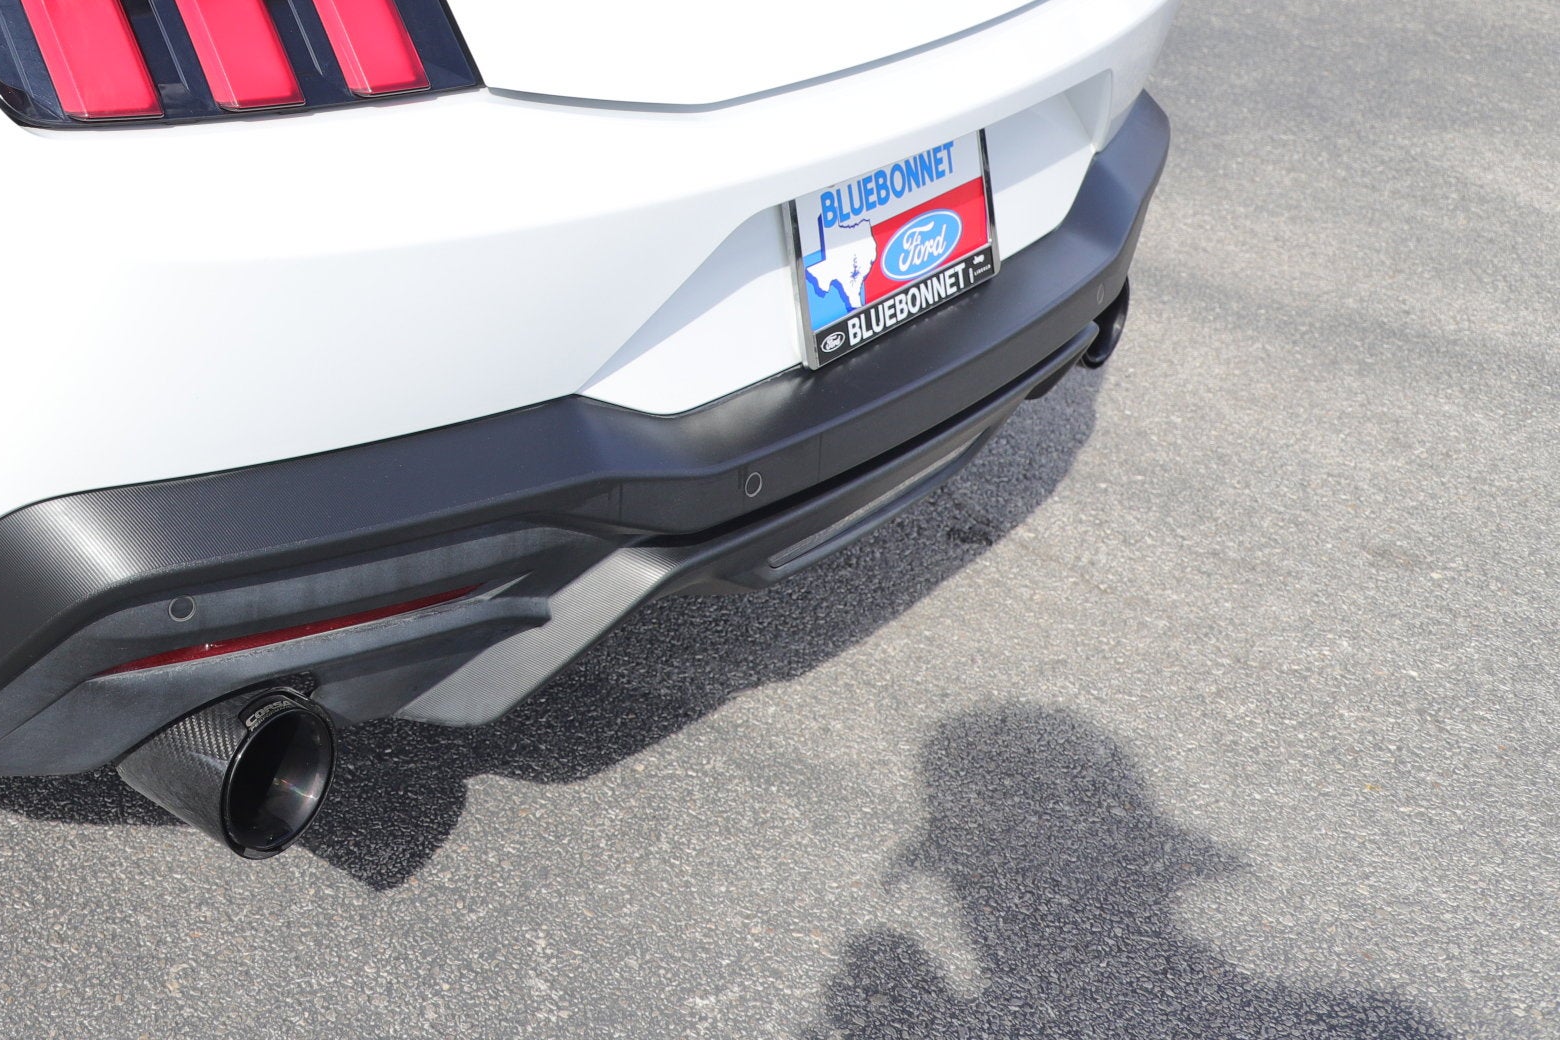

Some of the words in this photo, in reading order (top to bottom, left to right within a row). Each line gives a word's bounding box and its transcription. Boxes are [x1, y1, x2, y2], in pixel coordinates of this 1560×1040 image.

[820, 140, 955, 229] BLUEBONNET
[899, 221, 948, 272] Ford
[847, 262, 966, 347] BLUEBONNET
